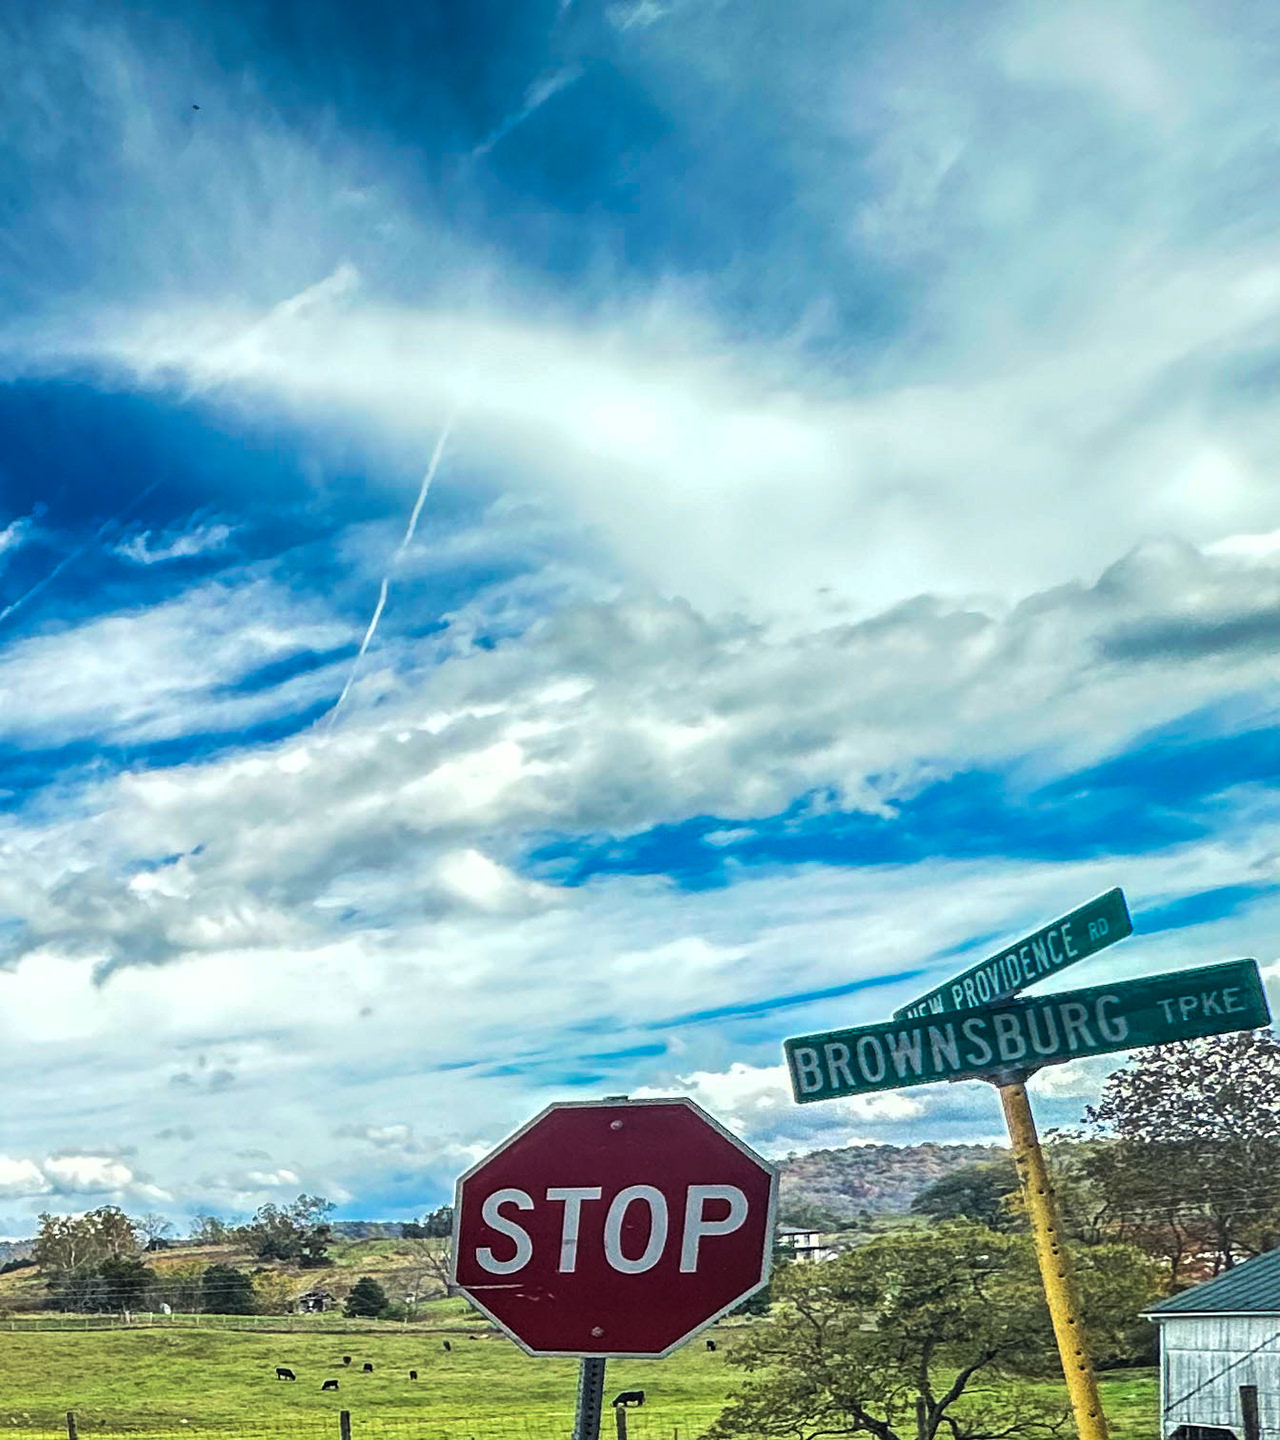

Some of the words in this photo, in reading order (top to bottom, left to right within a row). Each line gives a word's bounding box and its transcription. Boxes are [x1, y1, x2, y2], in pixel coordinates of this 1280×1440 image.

[951, 922, 1079, 1010] PROVIDENCE
[1087, 917, 1109, 942] RD
[794, 995, 1129, 1094] BROWNSBURG
[1156, 987, 1247, 1024] TPKE
[475, 1184, 749, 1275] STOP
